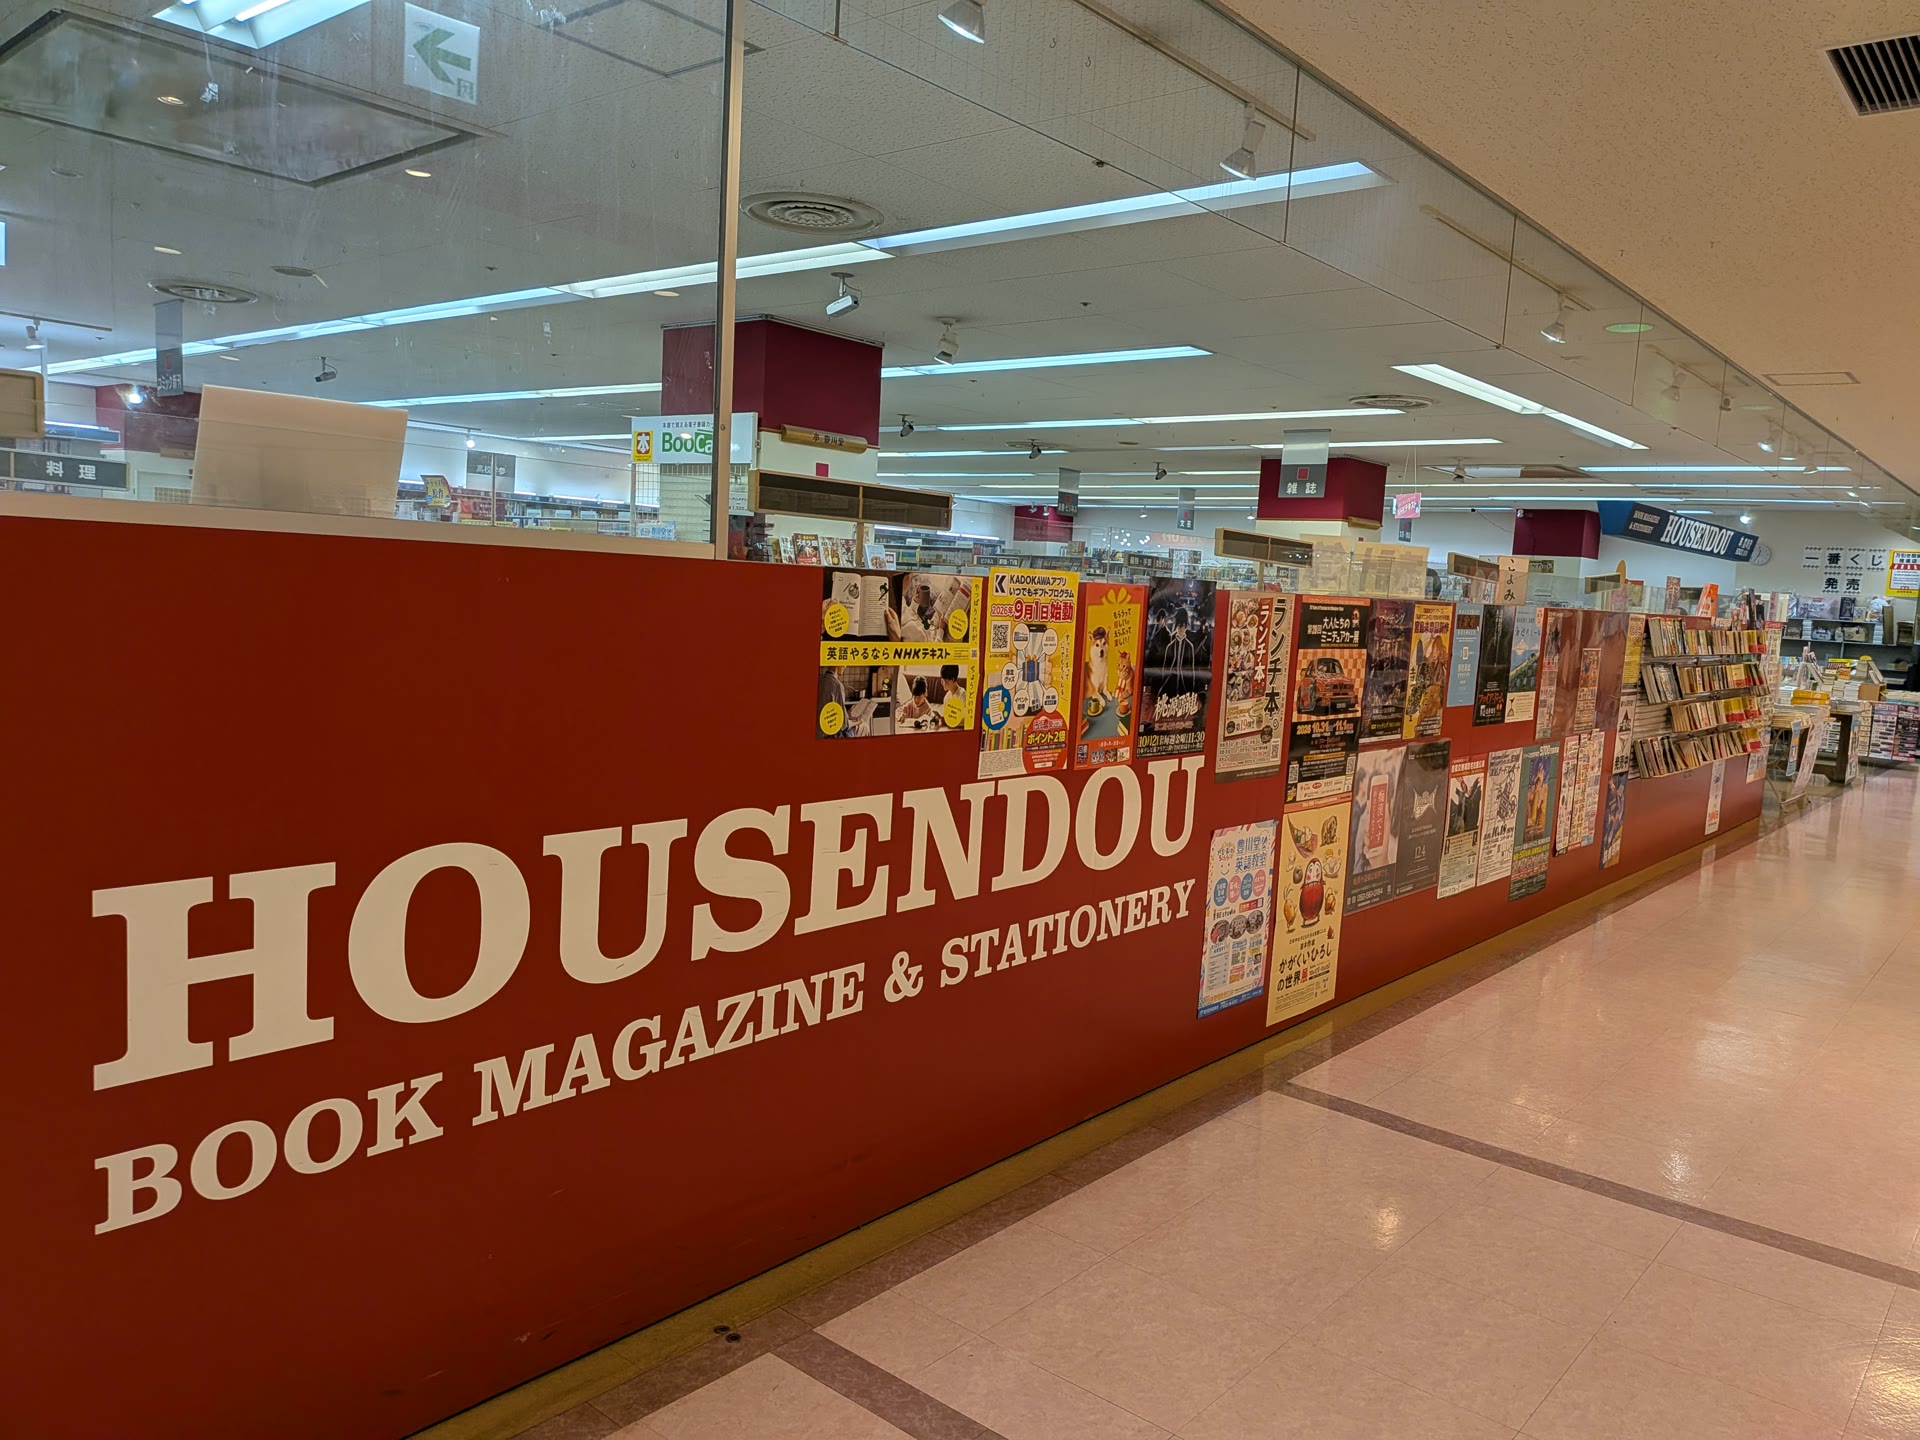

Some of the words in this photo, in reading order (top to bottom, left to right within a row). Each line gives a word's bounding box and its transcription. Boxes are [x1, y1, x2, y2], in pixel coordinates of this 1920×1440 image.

[46, 460, 97, 481] 料理
[1286, 482, 1317, 495] 雑誌
[1660, 515, 1735, 556] HOUSENDOU
[1804, 553, 1883, 567] 一番くじ
[1009, 575, 1067, 586] KADOKAWAアプリ
[1824, 577, 1861, 591] 発売
[1009, 587, 1074, 598] いつでもギフトプログラム
[991, 599, 1074, 621] 2026年9月1日始動
[1322, 616, 1351, 630] 大人たちの
[1320, 630, 1360, 643] ミニチュアカー展
[1027, 730, 1066, 745] ポイント2倍
[92, 755, 1205, 1091] HOUSENDOU
[1279, 943, 1332, 974] かがくいひろし
[1277, 967, 1309, 992] の世界展
[94, 1071, 443, 1236] BOOK
[472, 962, 865, 1126] MAGAZINE
[884, 951, 924, 1002] &
[940, 878, 1196, 988] STATIONERY
